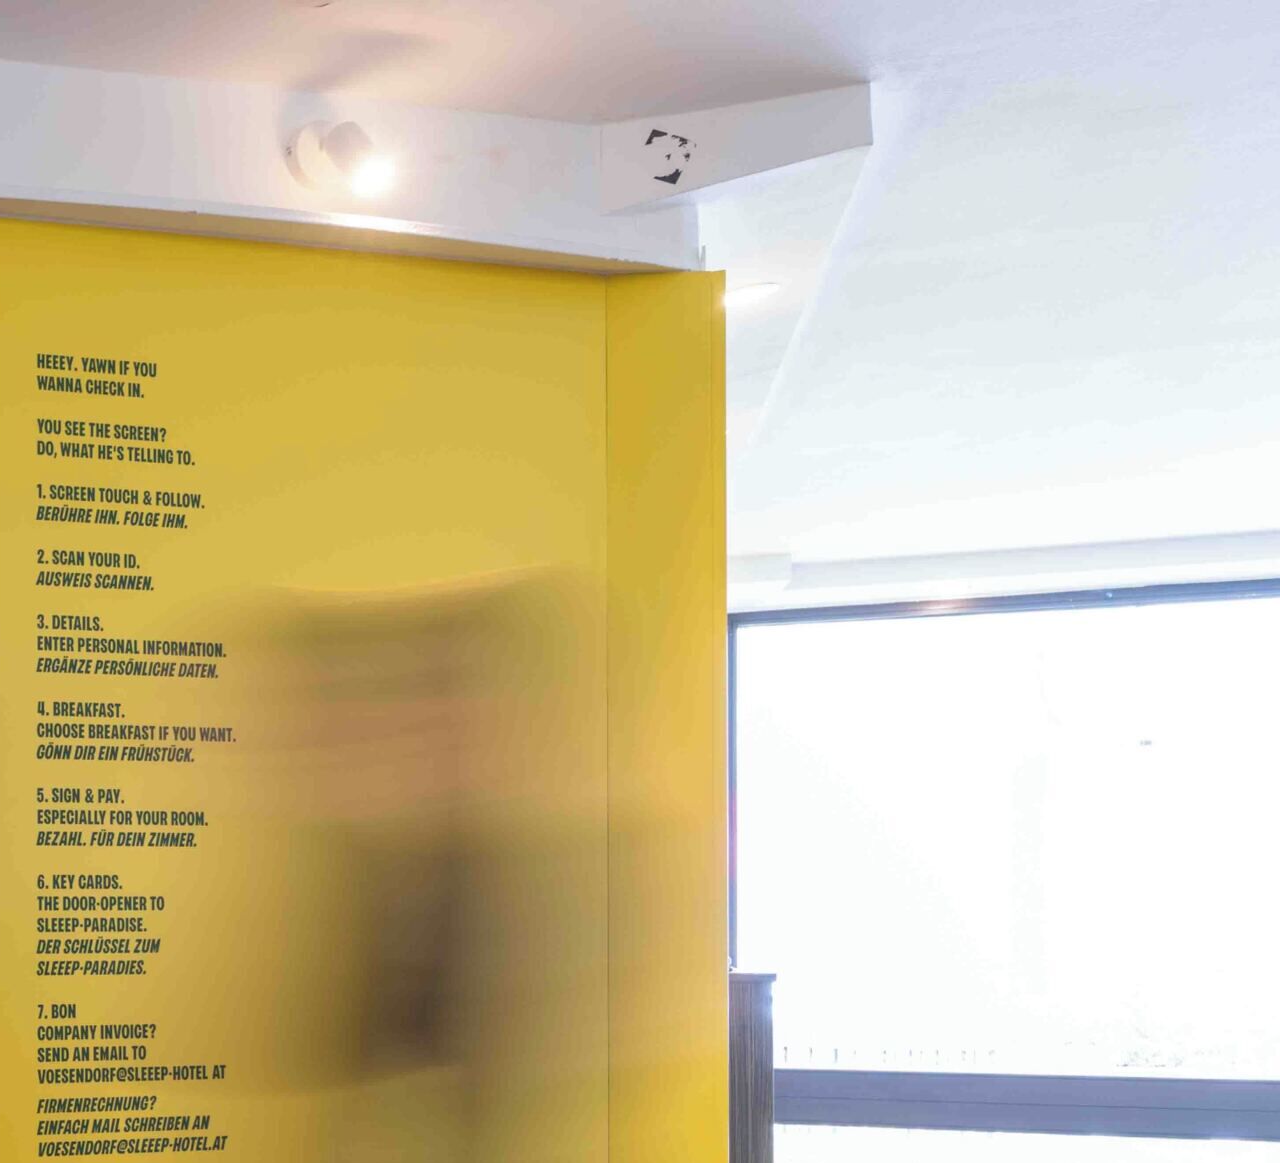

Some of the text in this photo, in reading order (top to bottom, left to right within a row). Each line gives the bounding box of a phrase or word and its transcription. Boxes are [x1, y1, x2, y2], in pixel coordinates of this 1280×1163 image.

[37, 354, 158, 378] HEEEY. YAWN IF YOU
[37, 376, 144, 398] WANNA CHECK IN.
[37, 419, 167, 443] YOU SEE THE SCREEN?
[37, 441, 195, 465] DO, WHAT HE'S TELLING TO.
[37, 484, 205, 509] 1. SCREEN TOUCH & FOLLOW.
[37, 549, 140, 569] 2. SCAN YOUR ID.
[37, 572, 155, 591] AUSWEIS SCANNEN.
[37, 615, 104, 632] 3. DETAILS.
[37, 637, 226, 658] ENTER PERSONAL INFORMATION.
[37, 702, 126, 719] 4. BREAKFAST.
[37, 723, 236, 743] CHOOSE BREAKFAST IF YOU WANT.
[36, 788, 125, 804] 5. SIGN & PAY.
[37, 810, 208, 826] ESPECIALLY FOR YOUR ROOM.
[37, 875, 123, 889] 6. KEY CARDS.
[38, 896, 165, 911] THE DOOR-OPENER TO
[37, 918, 147, 933] SLEEEP-PARADISE.
[38, 1004, 77, 1019] 7. BON
[37, 1024, 157, 1041] COMPANY INVOICE?
[37, 1045, 147, 1062] SEND AN EMAIL TO
[37, 1096, 156, 1114] FIRMENRECHNUNG?
[38, 1135, 227, 1157] VOESENDORF@SLEEEP-HOTEL.AT
